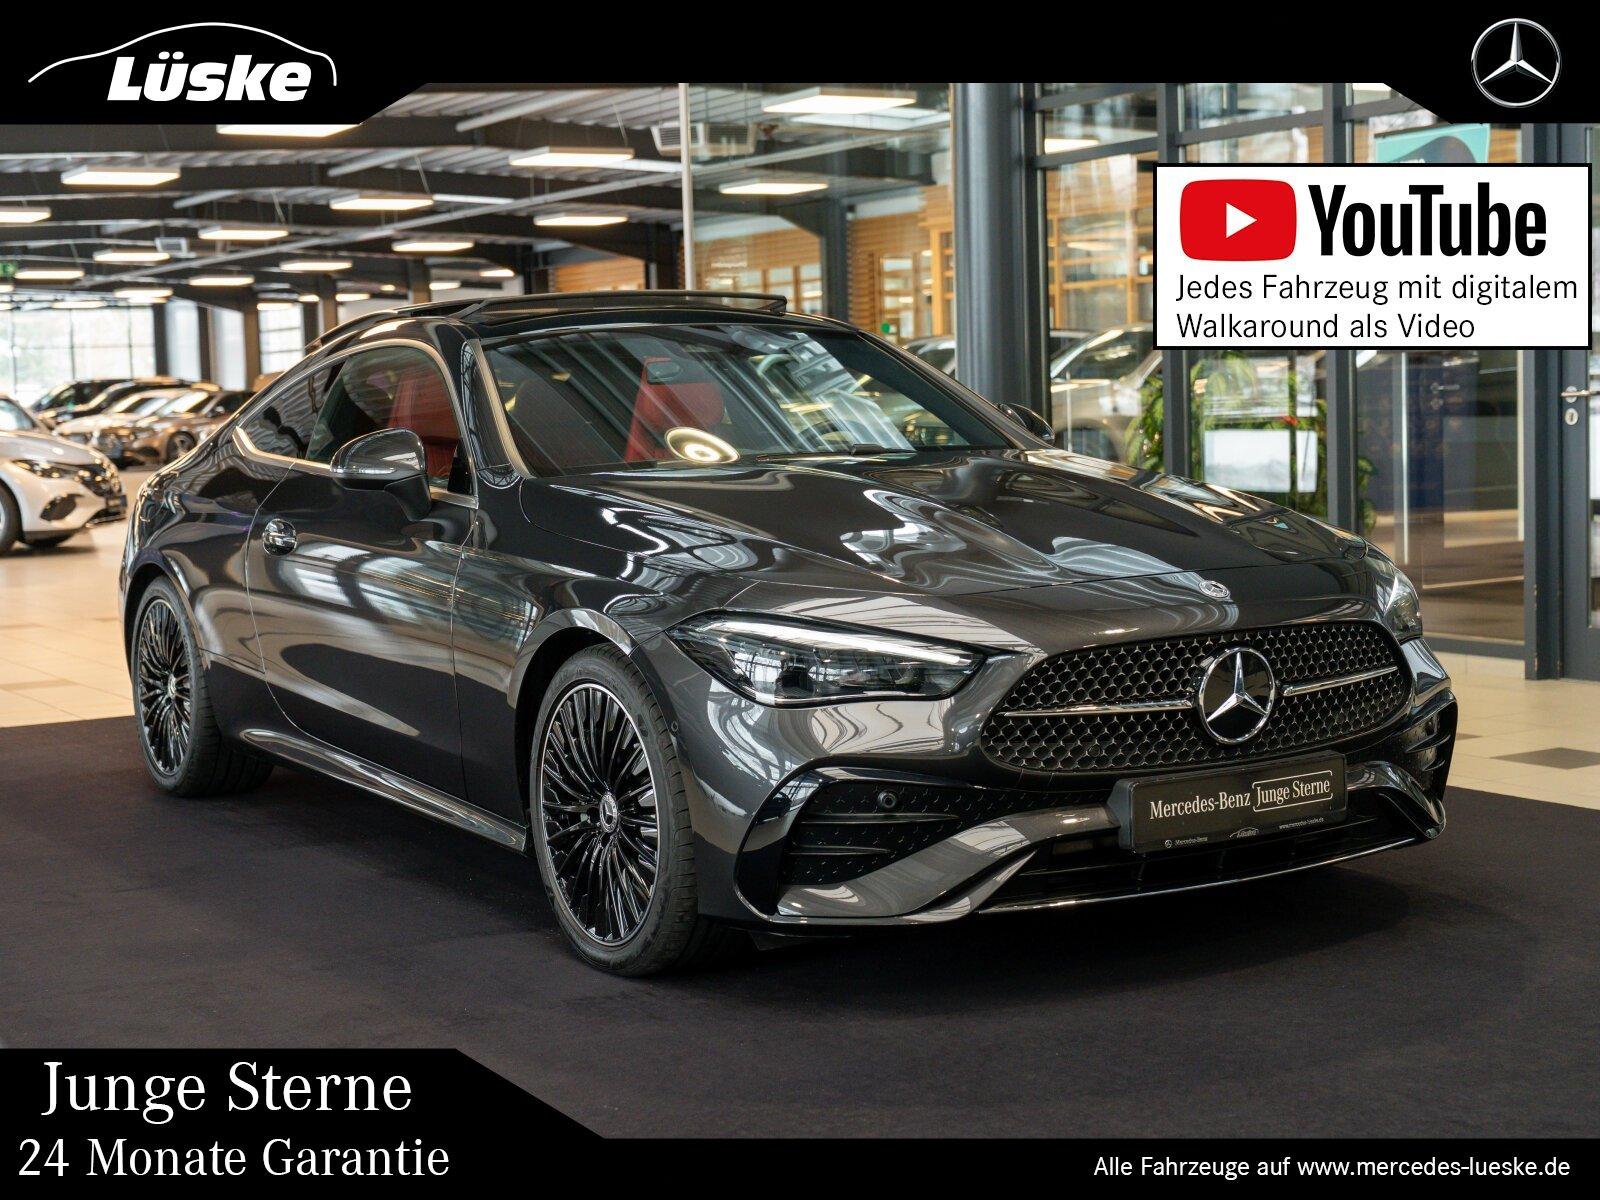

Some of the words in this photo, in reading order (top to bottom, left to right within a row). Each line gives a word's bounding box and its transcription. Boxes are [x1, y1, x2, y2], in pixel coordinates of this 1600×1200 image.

[1150, 791, 1251, 820] Mercedes-Benz
[1255, 785, 1290, 807] Junge
[1292, 778, 1331, 799] Sterne
